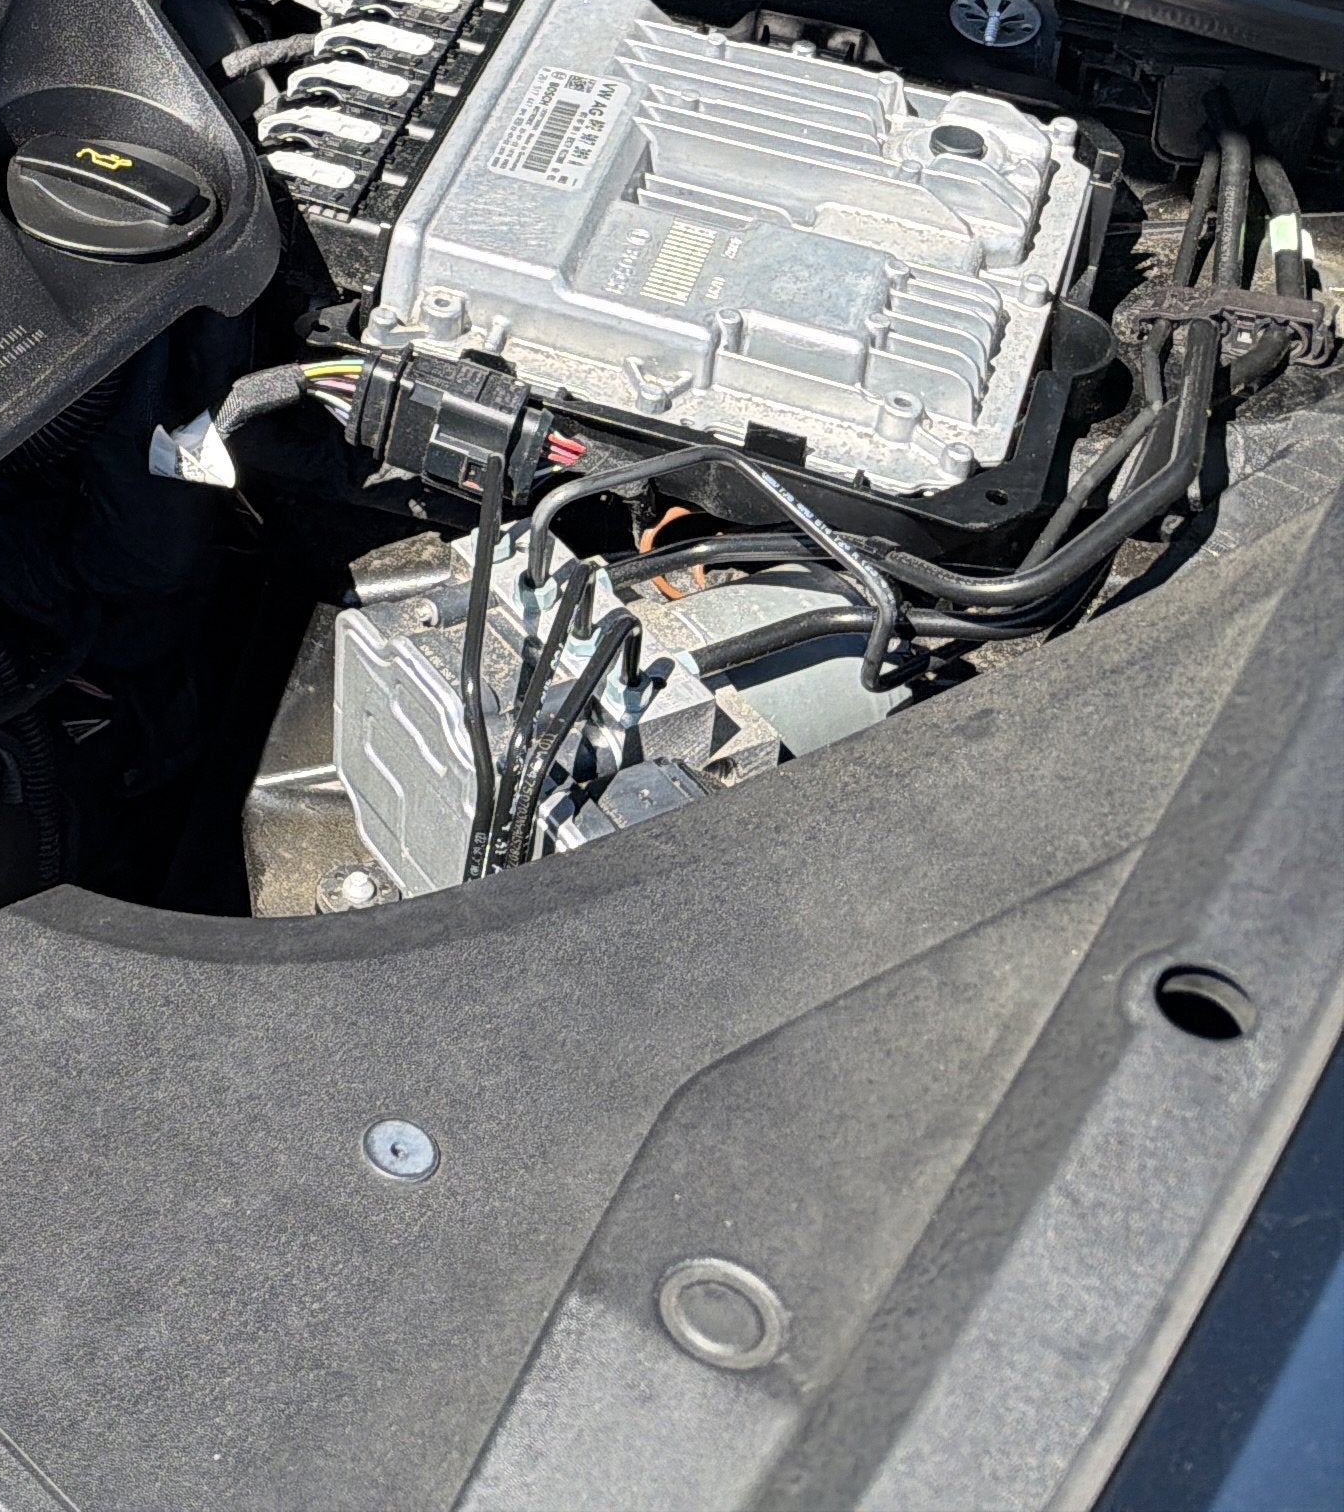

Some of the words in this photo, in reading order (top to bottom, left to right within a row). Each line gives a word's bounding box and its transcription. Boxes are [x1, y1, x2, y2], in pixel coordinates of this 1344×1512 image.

[538, 81, 560, 106] BOSCH
[595, 81, 618, 100] VW
[587, 100, 608, 117] AG
